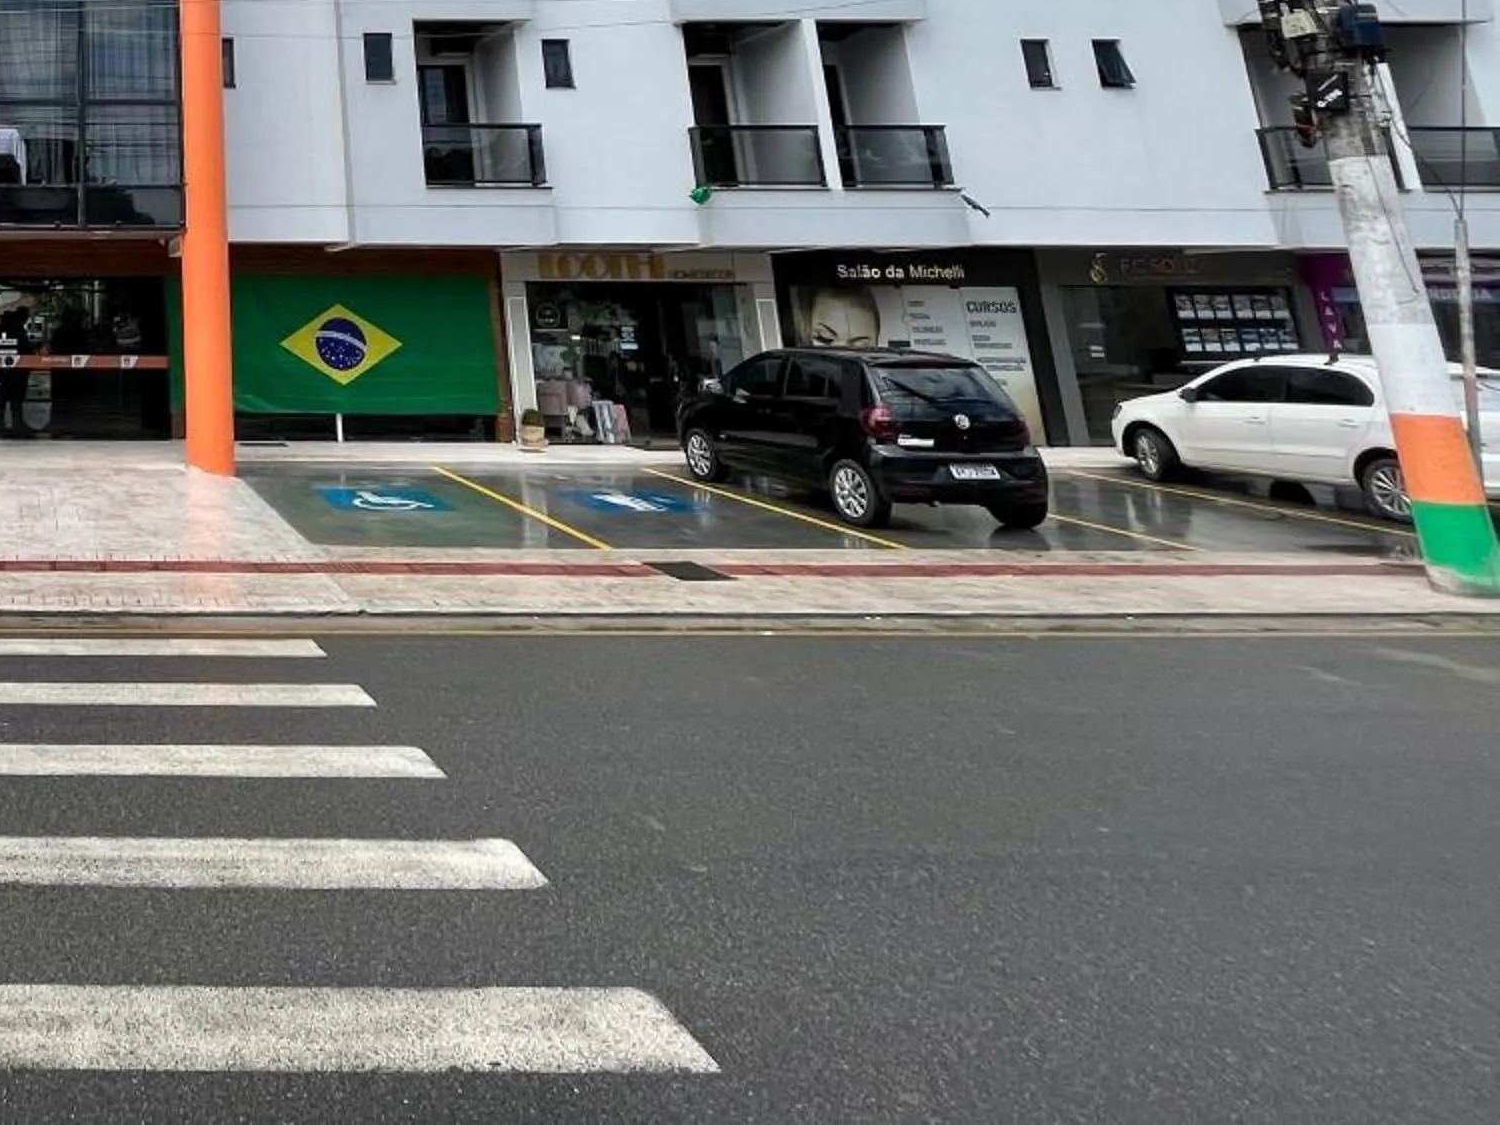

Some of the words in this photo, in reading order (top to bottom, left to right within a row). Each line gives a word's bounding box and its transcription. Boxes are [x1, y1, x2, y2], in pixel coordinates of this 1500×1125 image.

[837, 264, 881, 278] Salão
[885, 264, 904, 278] da
[966, 300, 1017, 314] CURSOS
